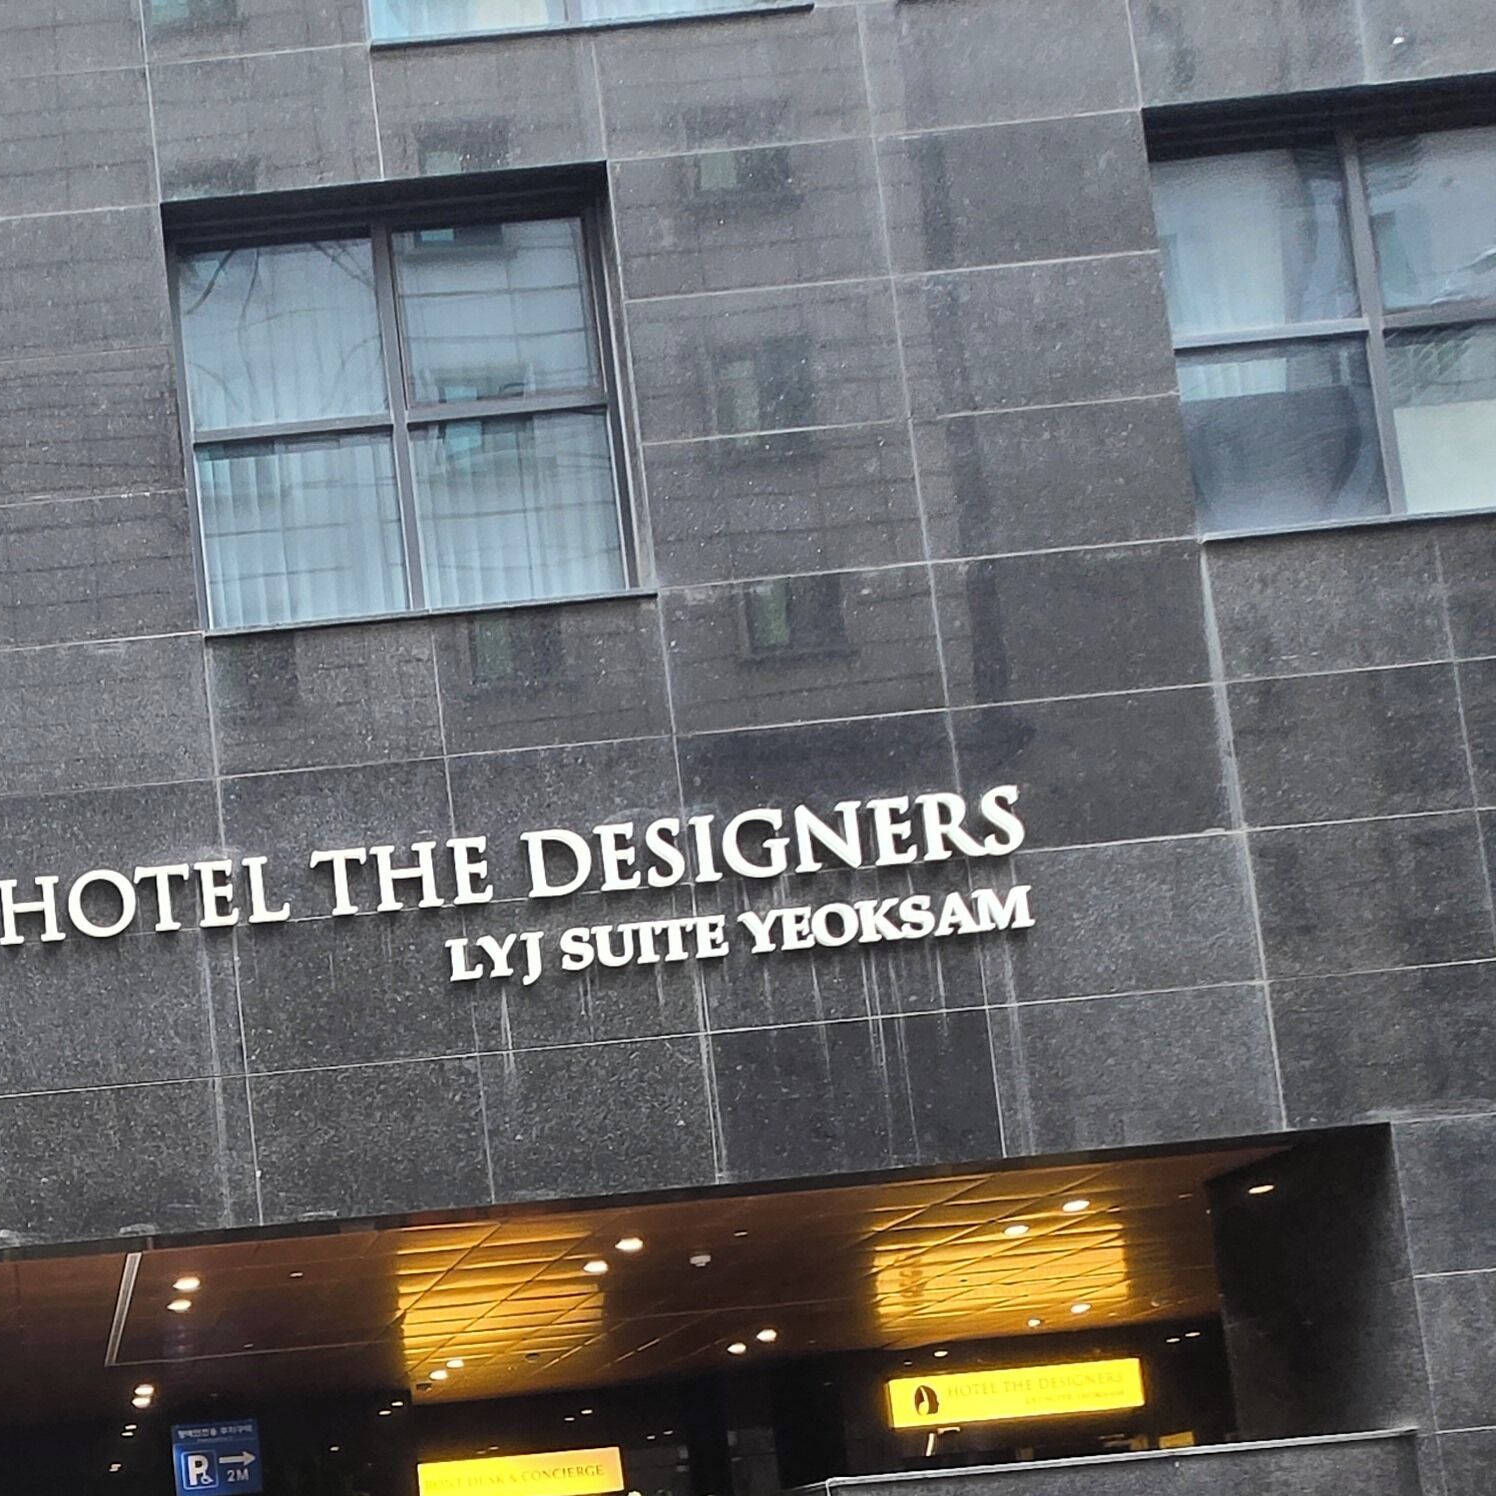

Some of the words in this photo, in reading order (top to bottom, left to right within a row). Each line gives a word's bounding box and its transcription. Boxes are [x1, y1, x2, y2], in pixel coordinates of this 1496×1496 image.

[309, 835, 494, 917] THE
[519, 784, 1027, 899] DESIGNERS
[445, 930, 545, 986] LYJ
[560, 913, 729, 972] SUITE
[737, 885, 1036, 954] YEOKSAM
[226, 1467, 250, 1483] 2M
[521, 1463, 605, 1483] CONCIERGE
